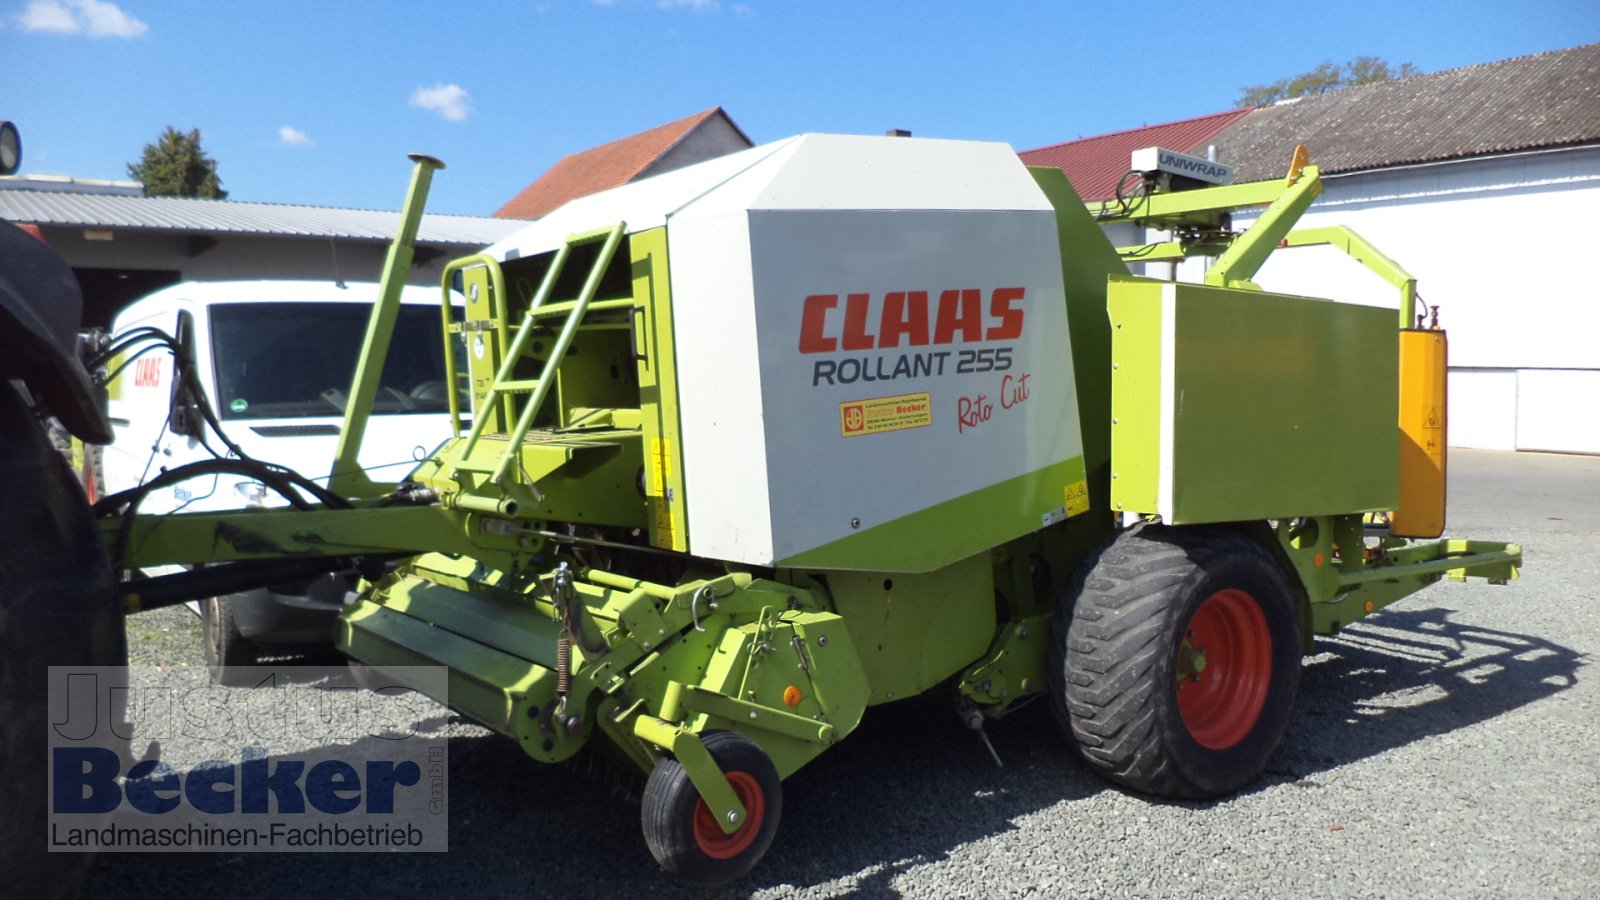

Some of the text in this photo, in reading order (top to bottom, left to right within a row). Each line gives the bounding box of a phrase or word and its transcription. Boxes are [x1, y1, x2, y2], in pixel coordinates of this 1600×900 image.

[1158, 153, 1227, 178] UNIWRAP
[798, 287, 1026, 354] CLAAS
[135, 357, 162, 387] CLAAS
[812, 347, 1013, 387] ROLLANT 255
[896, 404, 926, 414] Becker
[957, 371, 1031, 434] Roto Cut
